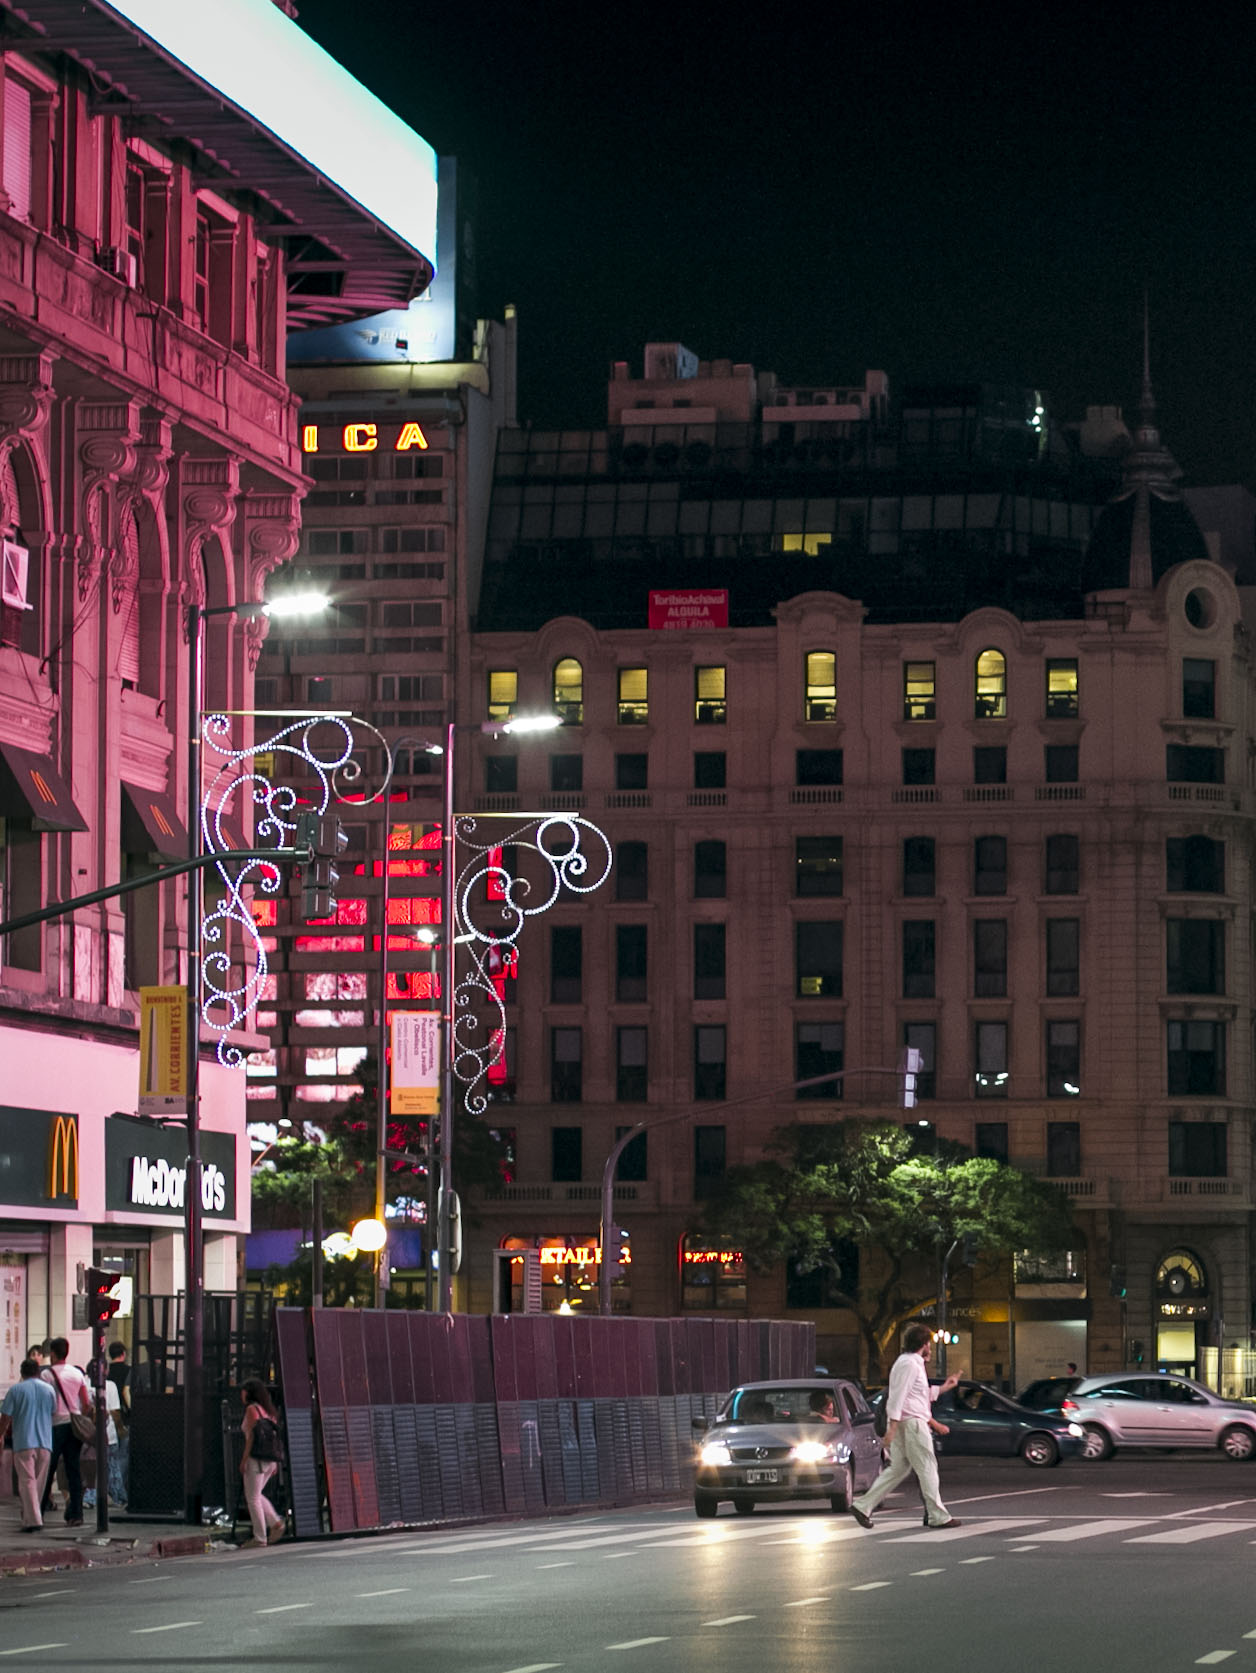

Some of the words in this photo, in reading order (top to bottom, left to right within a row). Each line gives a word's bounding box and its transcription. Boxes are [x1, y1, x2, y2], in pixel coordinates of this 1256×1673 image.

[667, 606, 710, 617] ALQUILA
[169, 1004, 182, 1075] CORRIENTES
[169, 1076, 181, 1092] AV.
